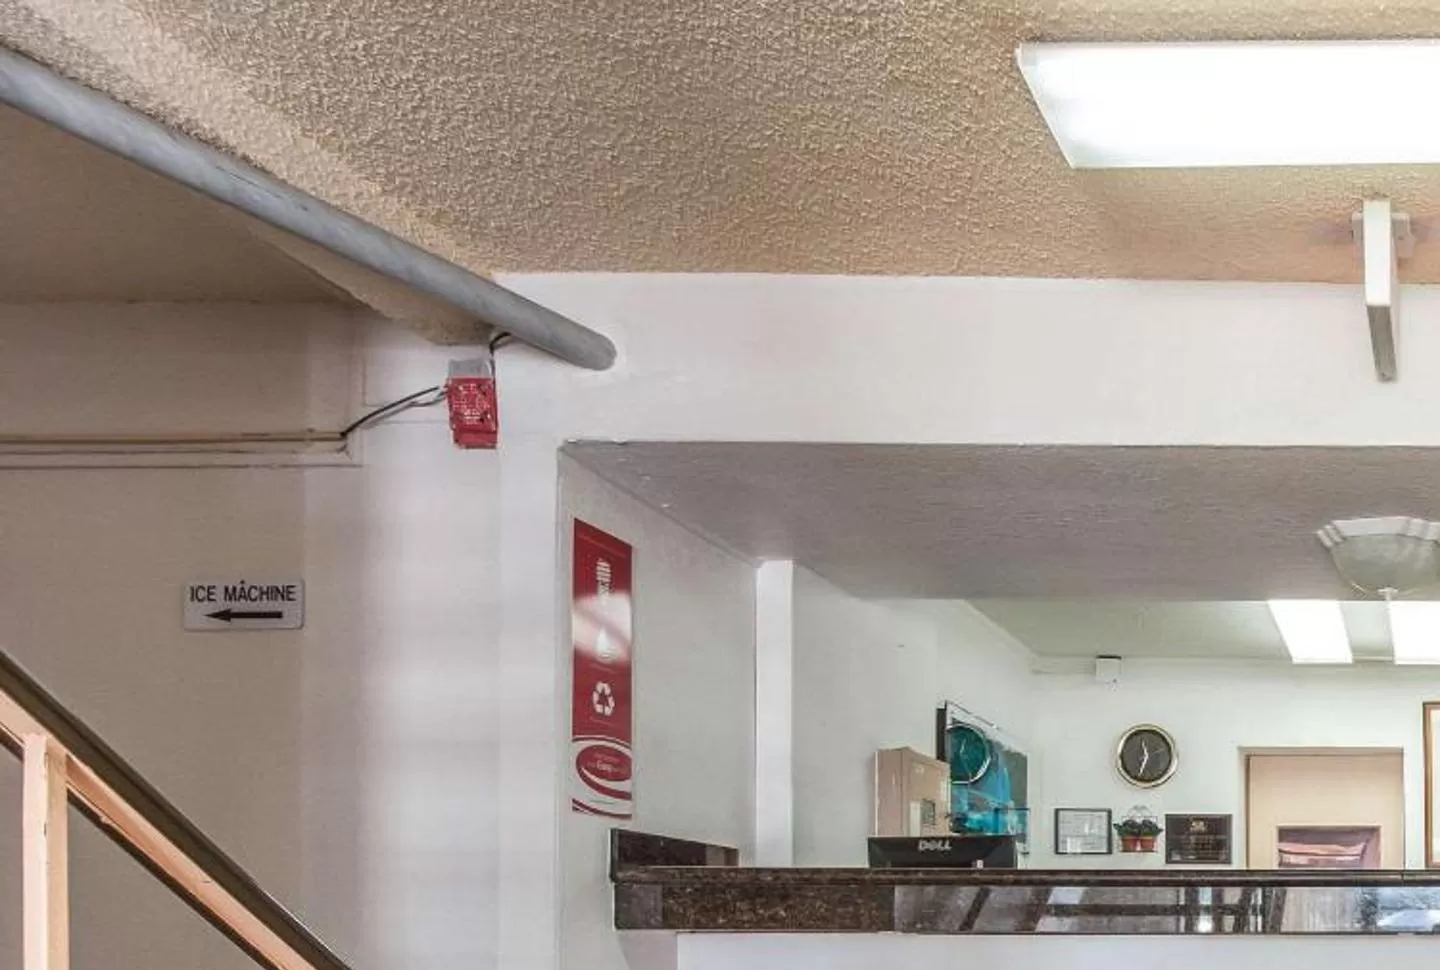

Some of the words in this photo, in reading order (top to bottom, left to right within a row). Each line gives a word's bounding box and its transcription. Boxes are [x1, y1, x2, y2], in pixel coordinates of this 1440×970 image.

[189, 584, 217, 602] ICE
[224, 584, 297, 602] MACHINE
[918, 839, 952, 851] DELL
